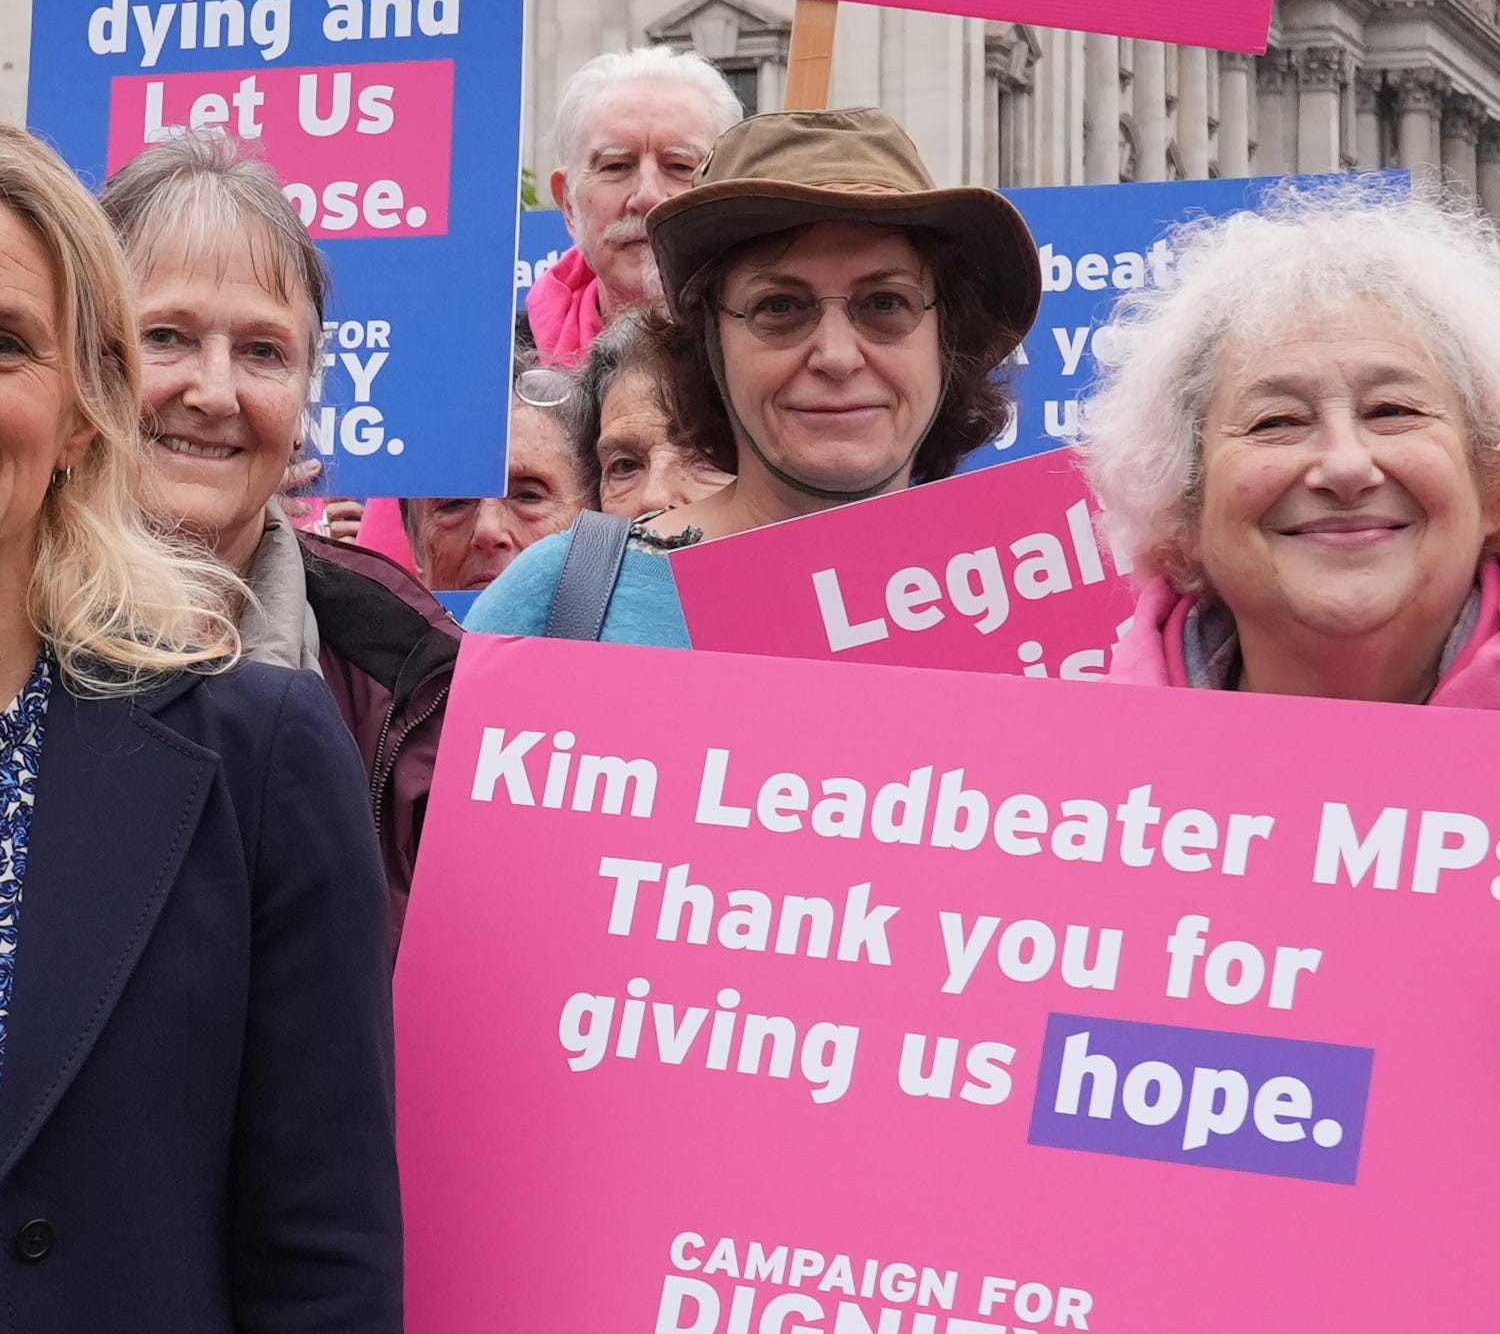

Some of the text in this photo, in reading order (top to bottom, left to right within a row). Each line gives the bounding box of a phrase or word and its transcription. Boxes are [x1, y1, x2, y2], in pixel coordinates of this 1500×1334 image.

[143, 73, 394, 144] Let Us
[812, 499, 1133, 652] Legal
[472, 728, 657, 817] Kim
[696, 749, 1274, 875] Leadbeater
[600, 858, 1322, 1009] Thank you for
[560, 978, 1342, 1150] giving us hope.
[671, 1232, 1093, 1329] CAMPAIGN FOR
